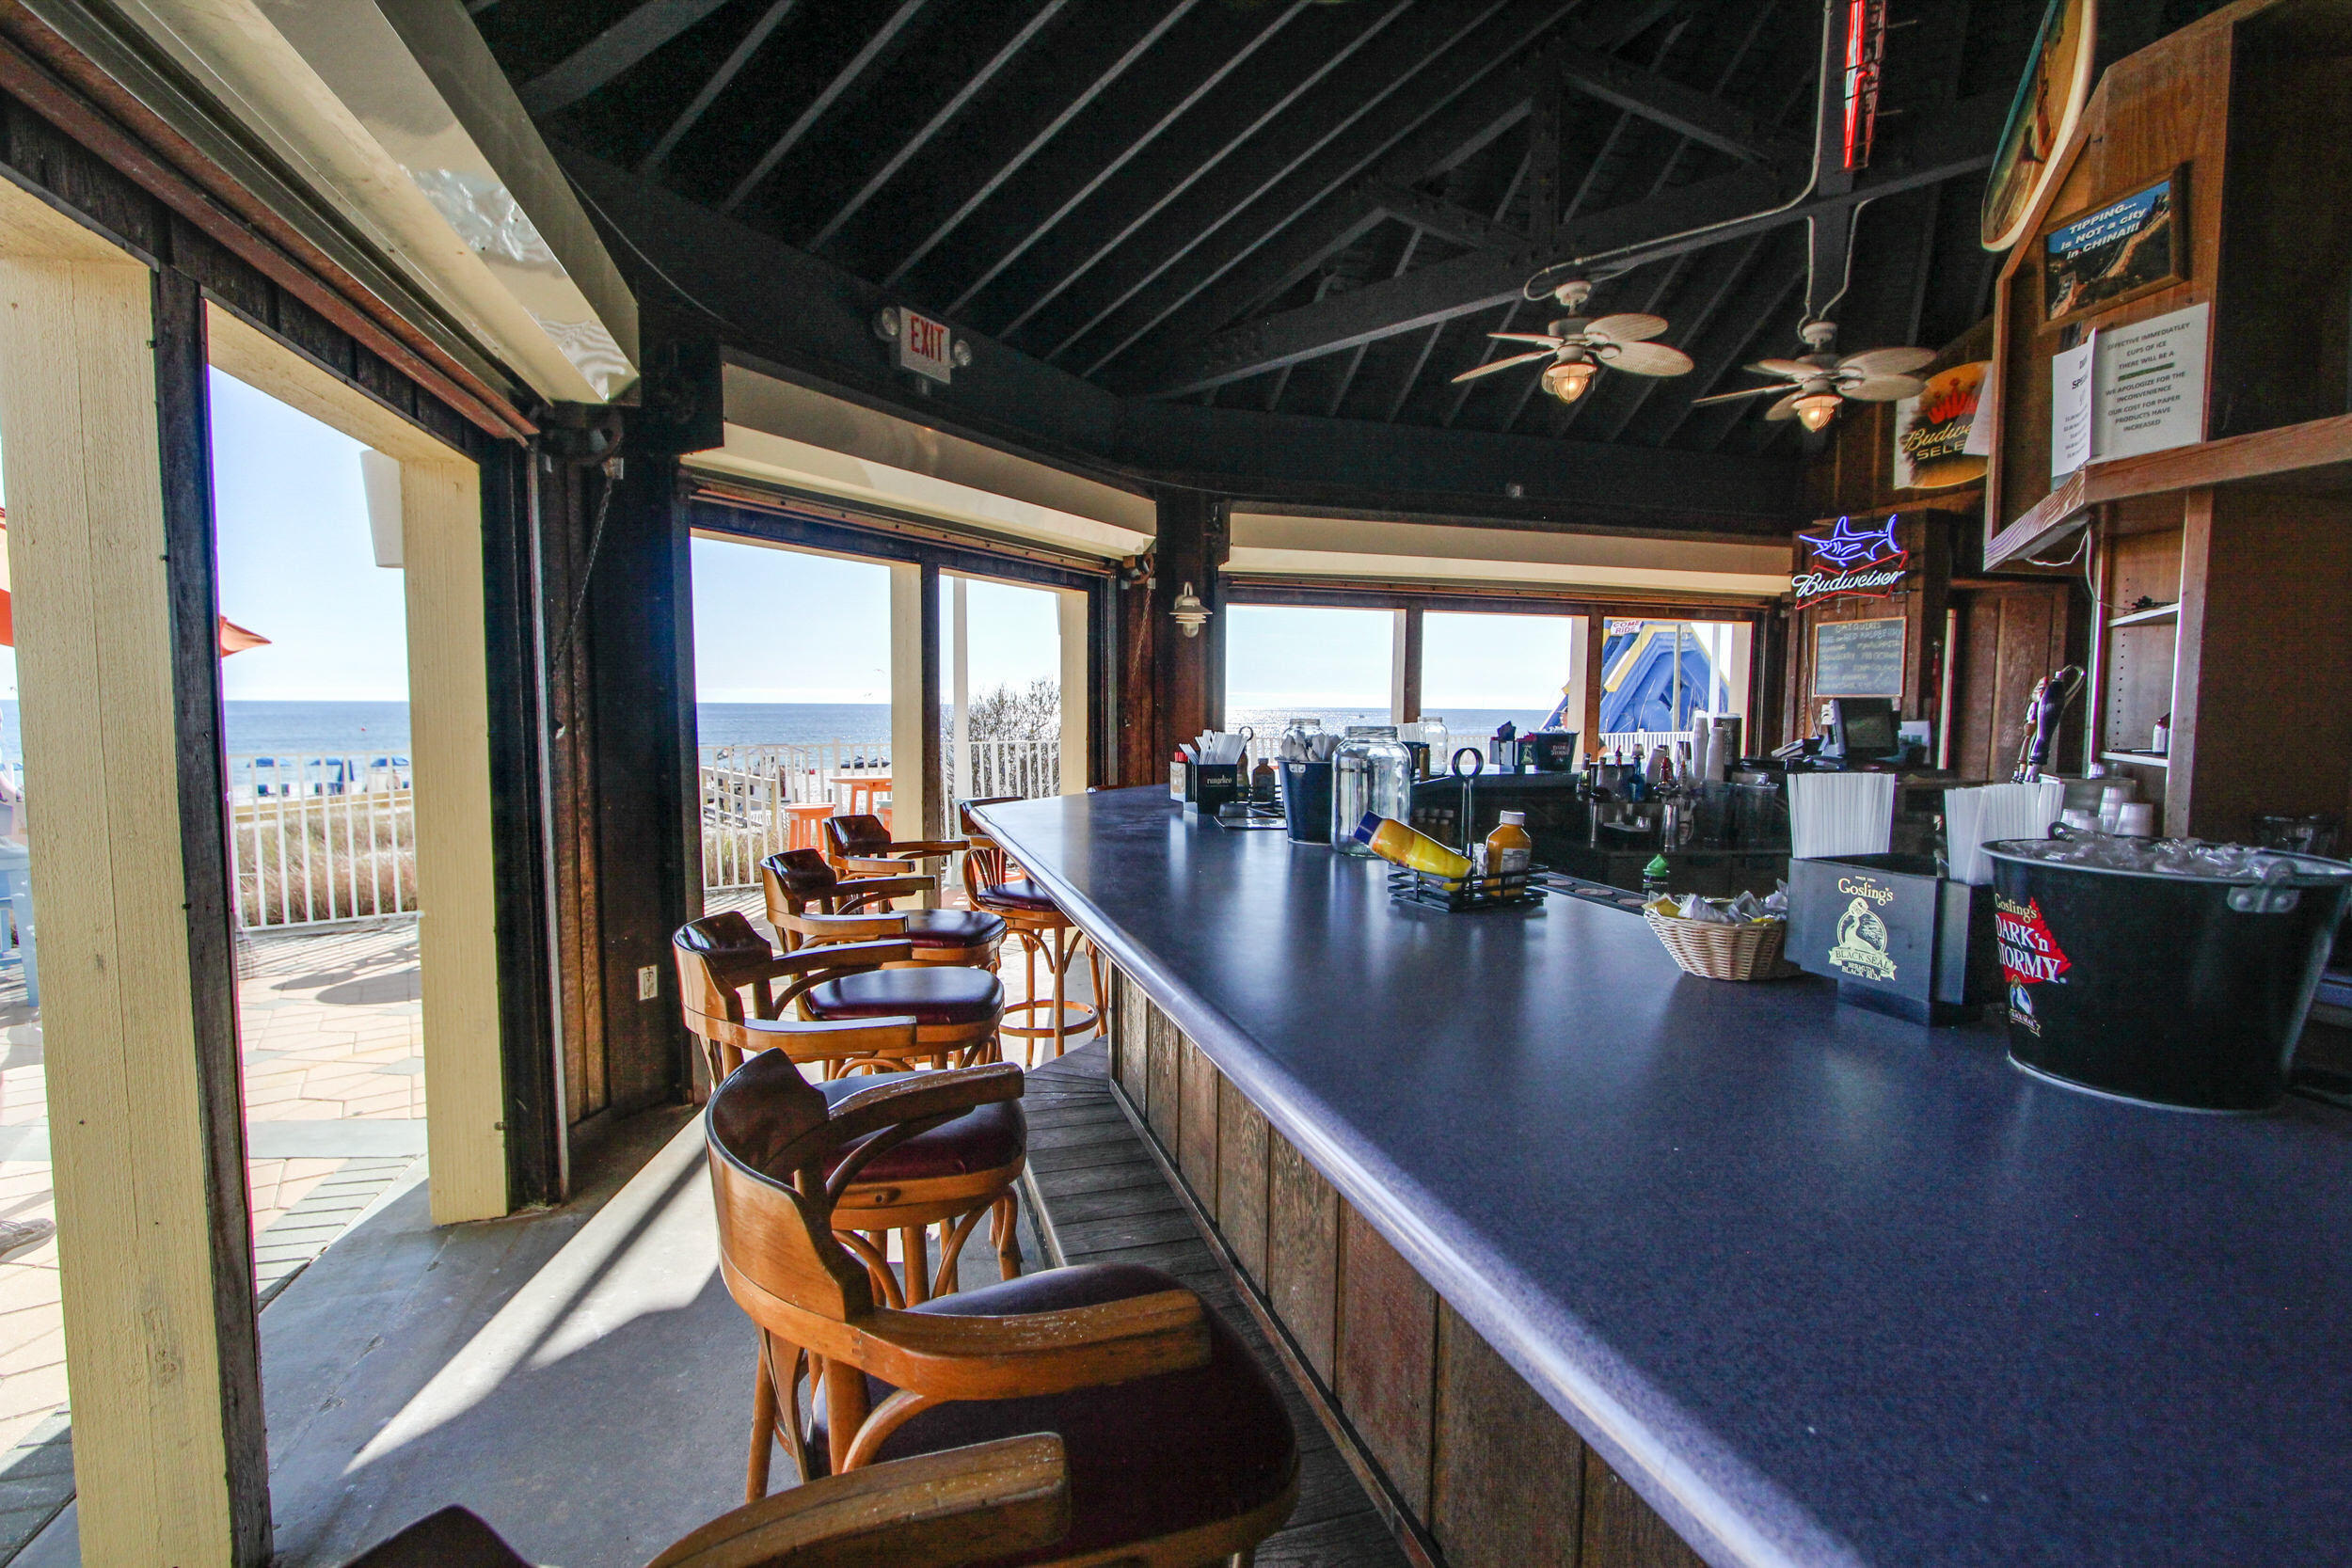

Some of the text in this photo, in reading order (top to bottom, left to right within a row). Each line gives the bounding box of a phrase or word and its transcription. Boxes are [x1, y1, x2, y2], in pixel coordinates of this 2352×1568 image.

[2070, 202, 2137, 234] TIPPING...
[2075, 225, 2106, 244] NOT
[2107, 222, 2117, 230] a
[2120, 208, 2148, 225] city
[2082, 221, 2141, 252] CHINA!!!
[911, 315, 945, 362] EXIT
[2107, 336, 2140, 351] EFFECTIVE
[2126, 346, 2144, 356] CUPS
[2119, 358, 2140, 370] THERE
[2140, 355, 2157, 364] WILL
[2117, 378, 2155, 393] APOLOGIZE
[2156, 374, 2171, 383] FOR
[2171, 371, 2186, 380] THE
[2117, 384, 2172, 403] INCONVENIENCE
[2107, 394, 2182, 417] OUR COST FOR PAPER
[2115, 406, 2172, 424] PRODUCTS HAVE
[2122, 419, 2162, 432] INCREASED
[1791, 569, 1906, 598] Budweiser
[1837, 878, 1895, 907] Gosling's
[1994, 893, 2038, 924] Gosling's
[1835, 949, 1891, 971] BLACK SEAL
[1841, 965, 1882, 982] BLACK RUM
